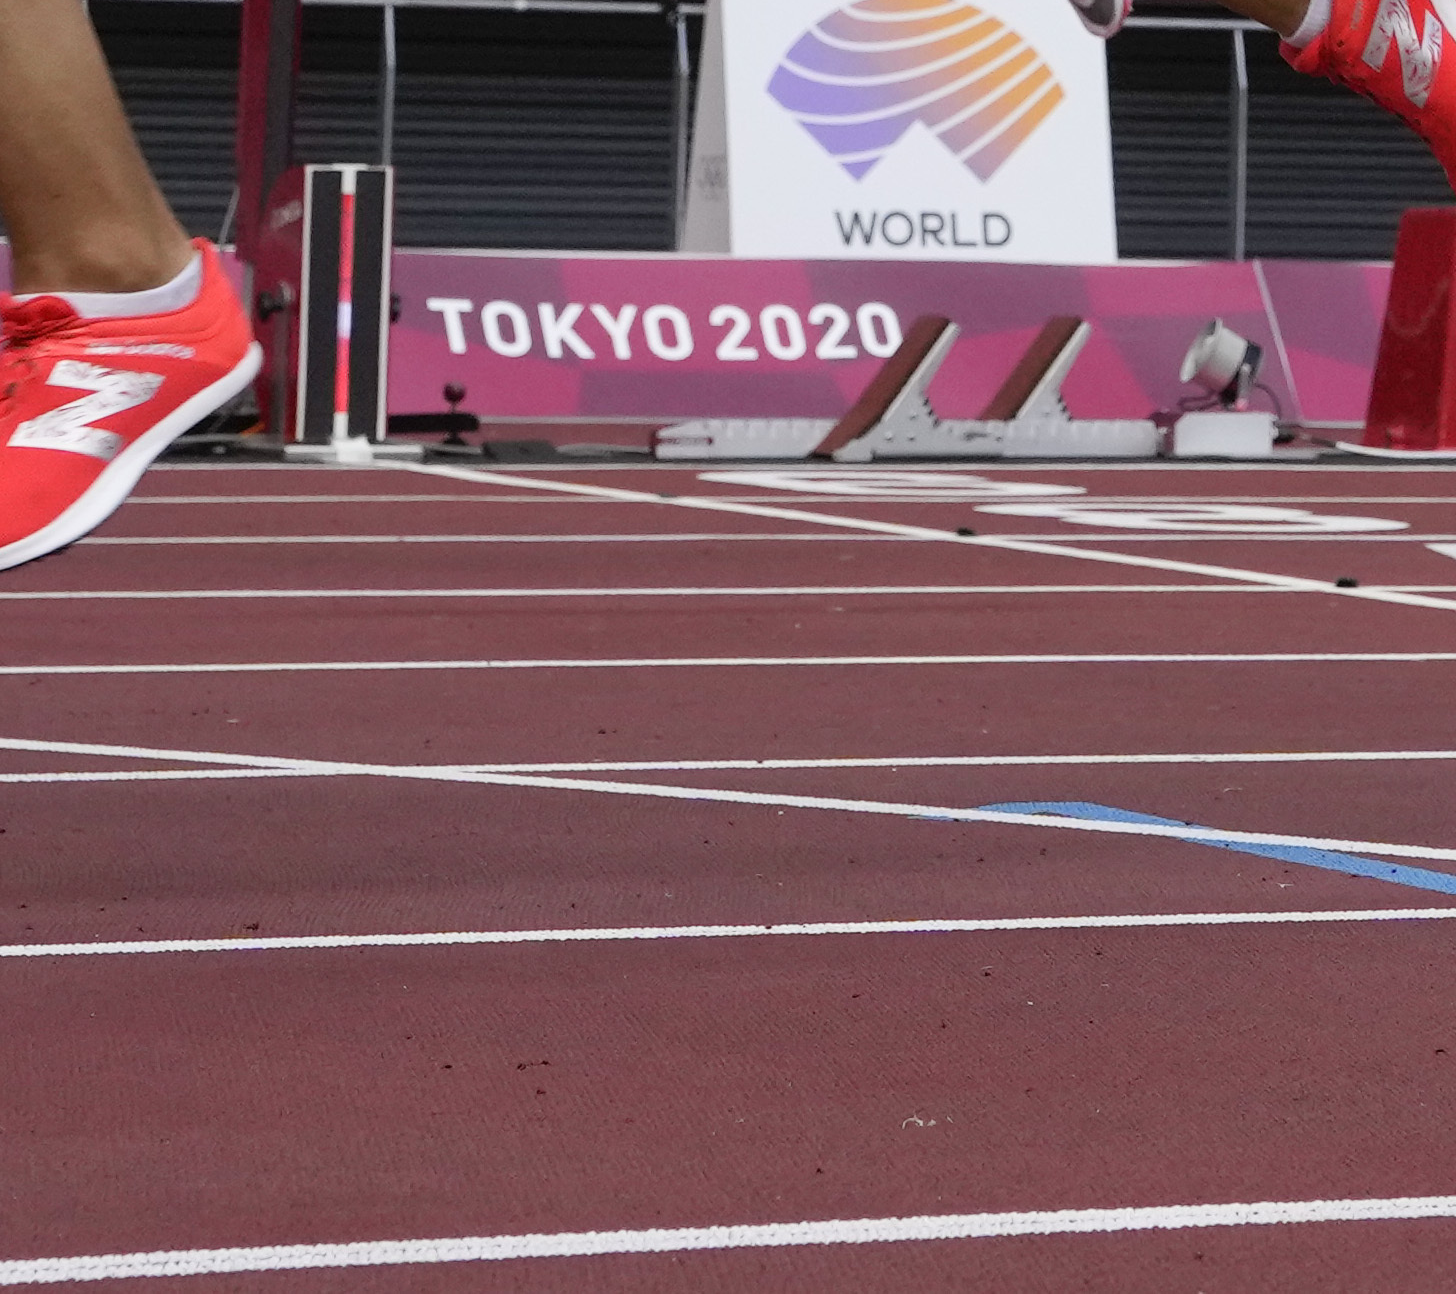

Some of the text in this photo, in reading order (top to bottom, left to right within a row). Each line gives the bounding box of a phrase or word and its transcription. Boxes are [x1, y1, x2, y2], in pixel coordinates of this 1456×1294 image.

[835, 210, 1012, 248] WORLD
[426, 297, 904, 362] TOKYO 2020
